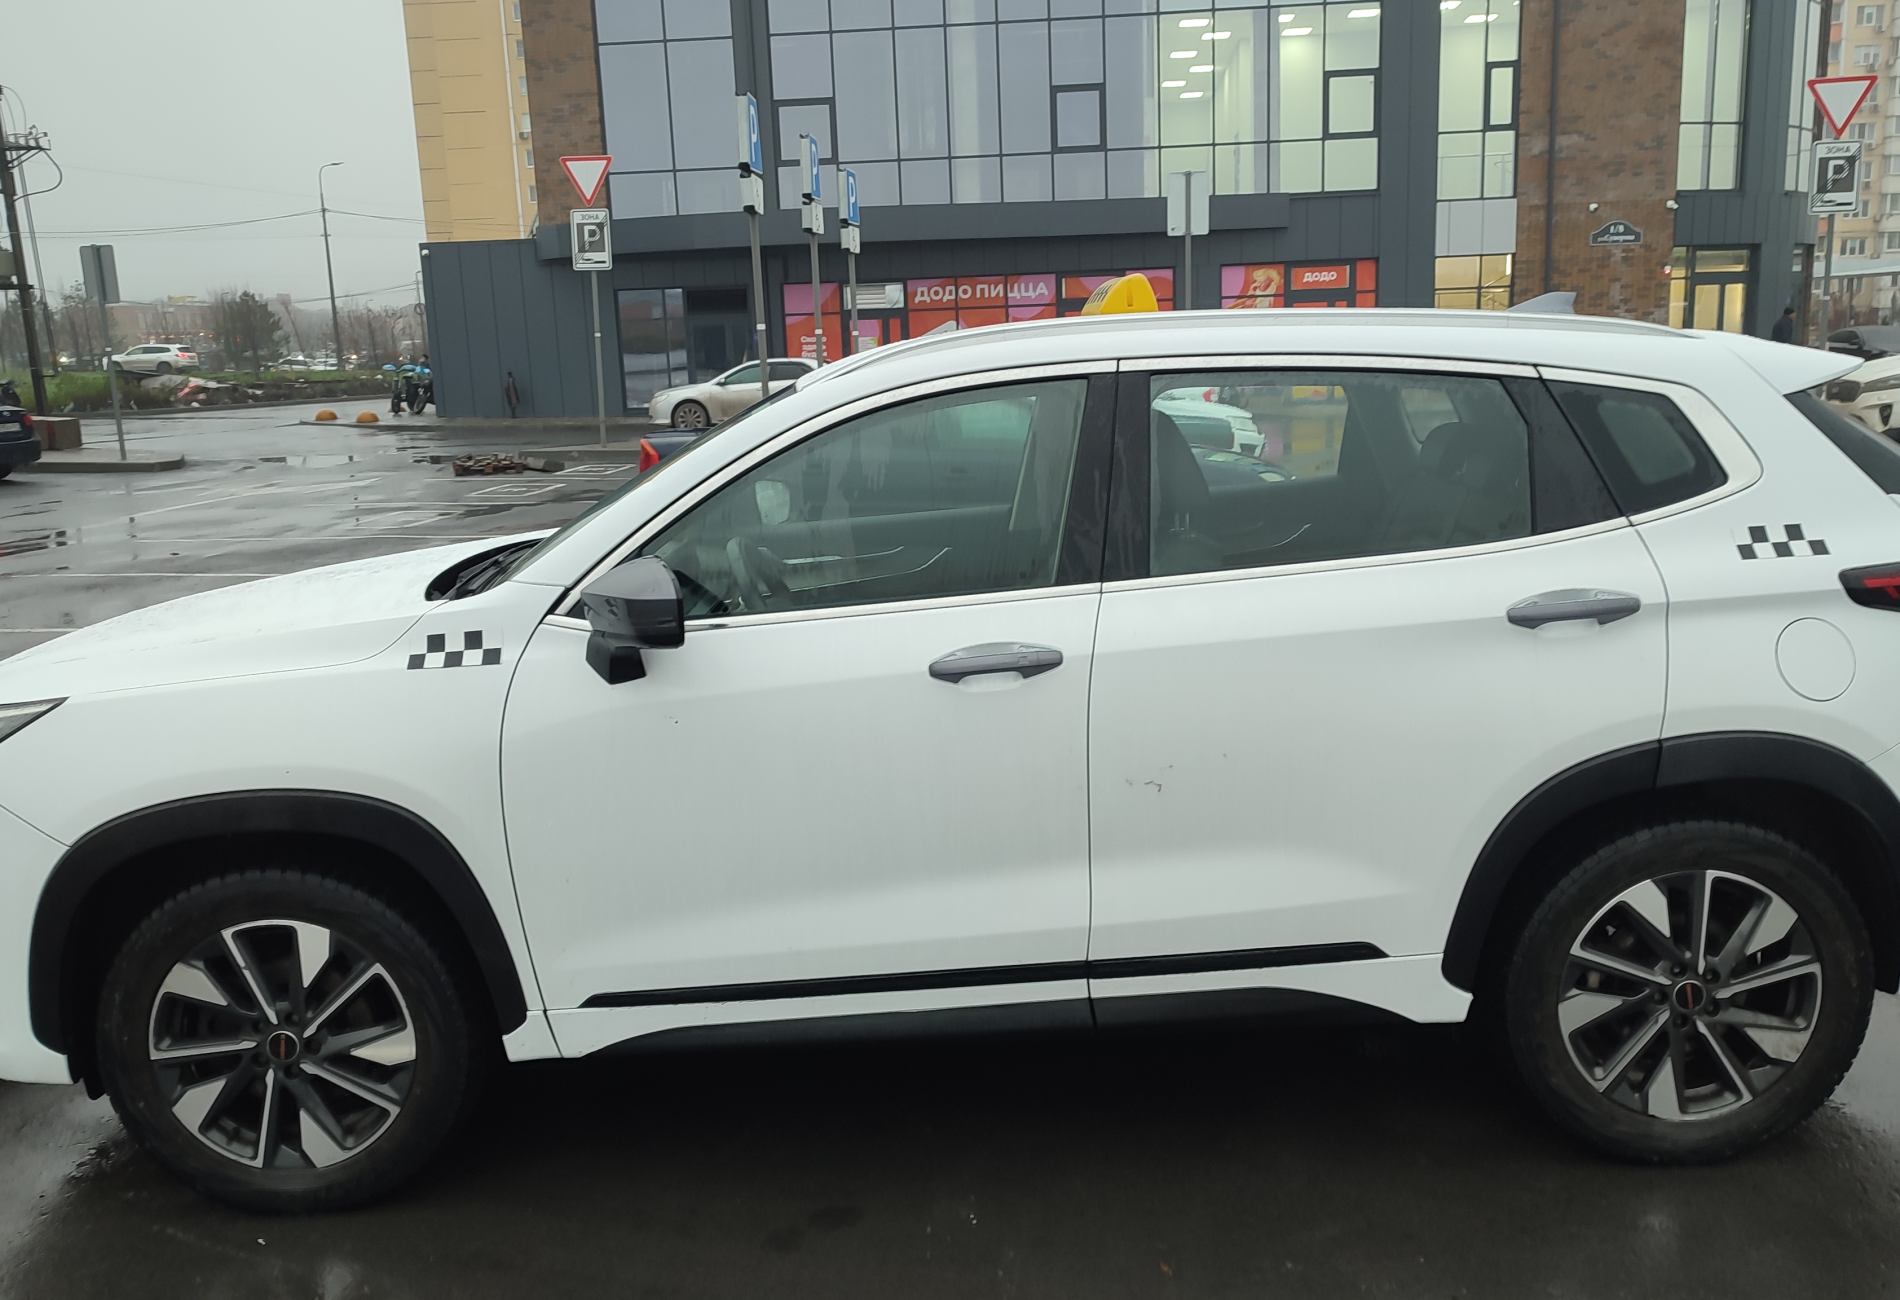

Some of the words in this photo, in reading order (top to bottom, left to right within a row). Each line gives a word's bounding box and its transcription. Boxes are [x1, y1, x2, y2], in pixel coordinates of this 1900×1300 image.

[1825, 145, 1852, 155] ЗОНА
[580, 213, 601, 221] ЗОНА
[1302, 271, 1338, 283] ДОДО
[914, 284, 973, 304] ДОДО
[976, 281, 1049, 299] ПИЦЦА
[800, 335, 827, 343] Скоо
